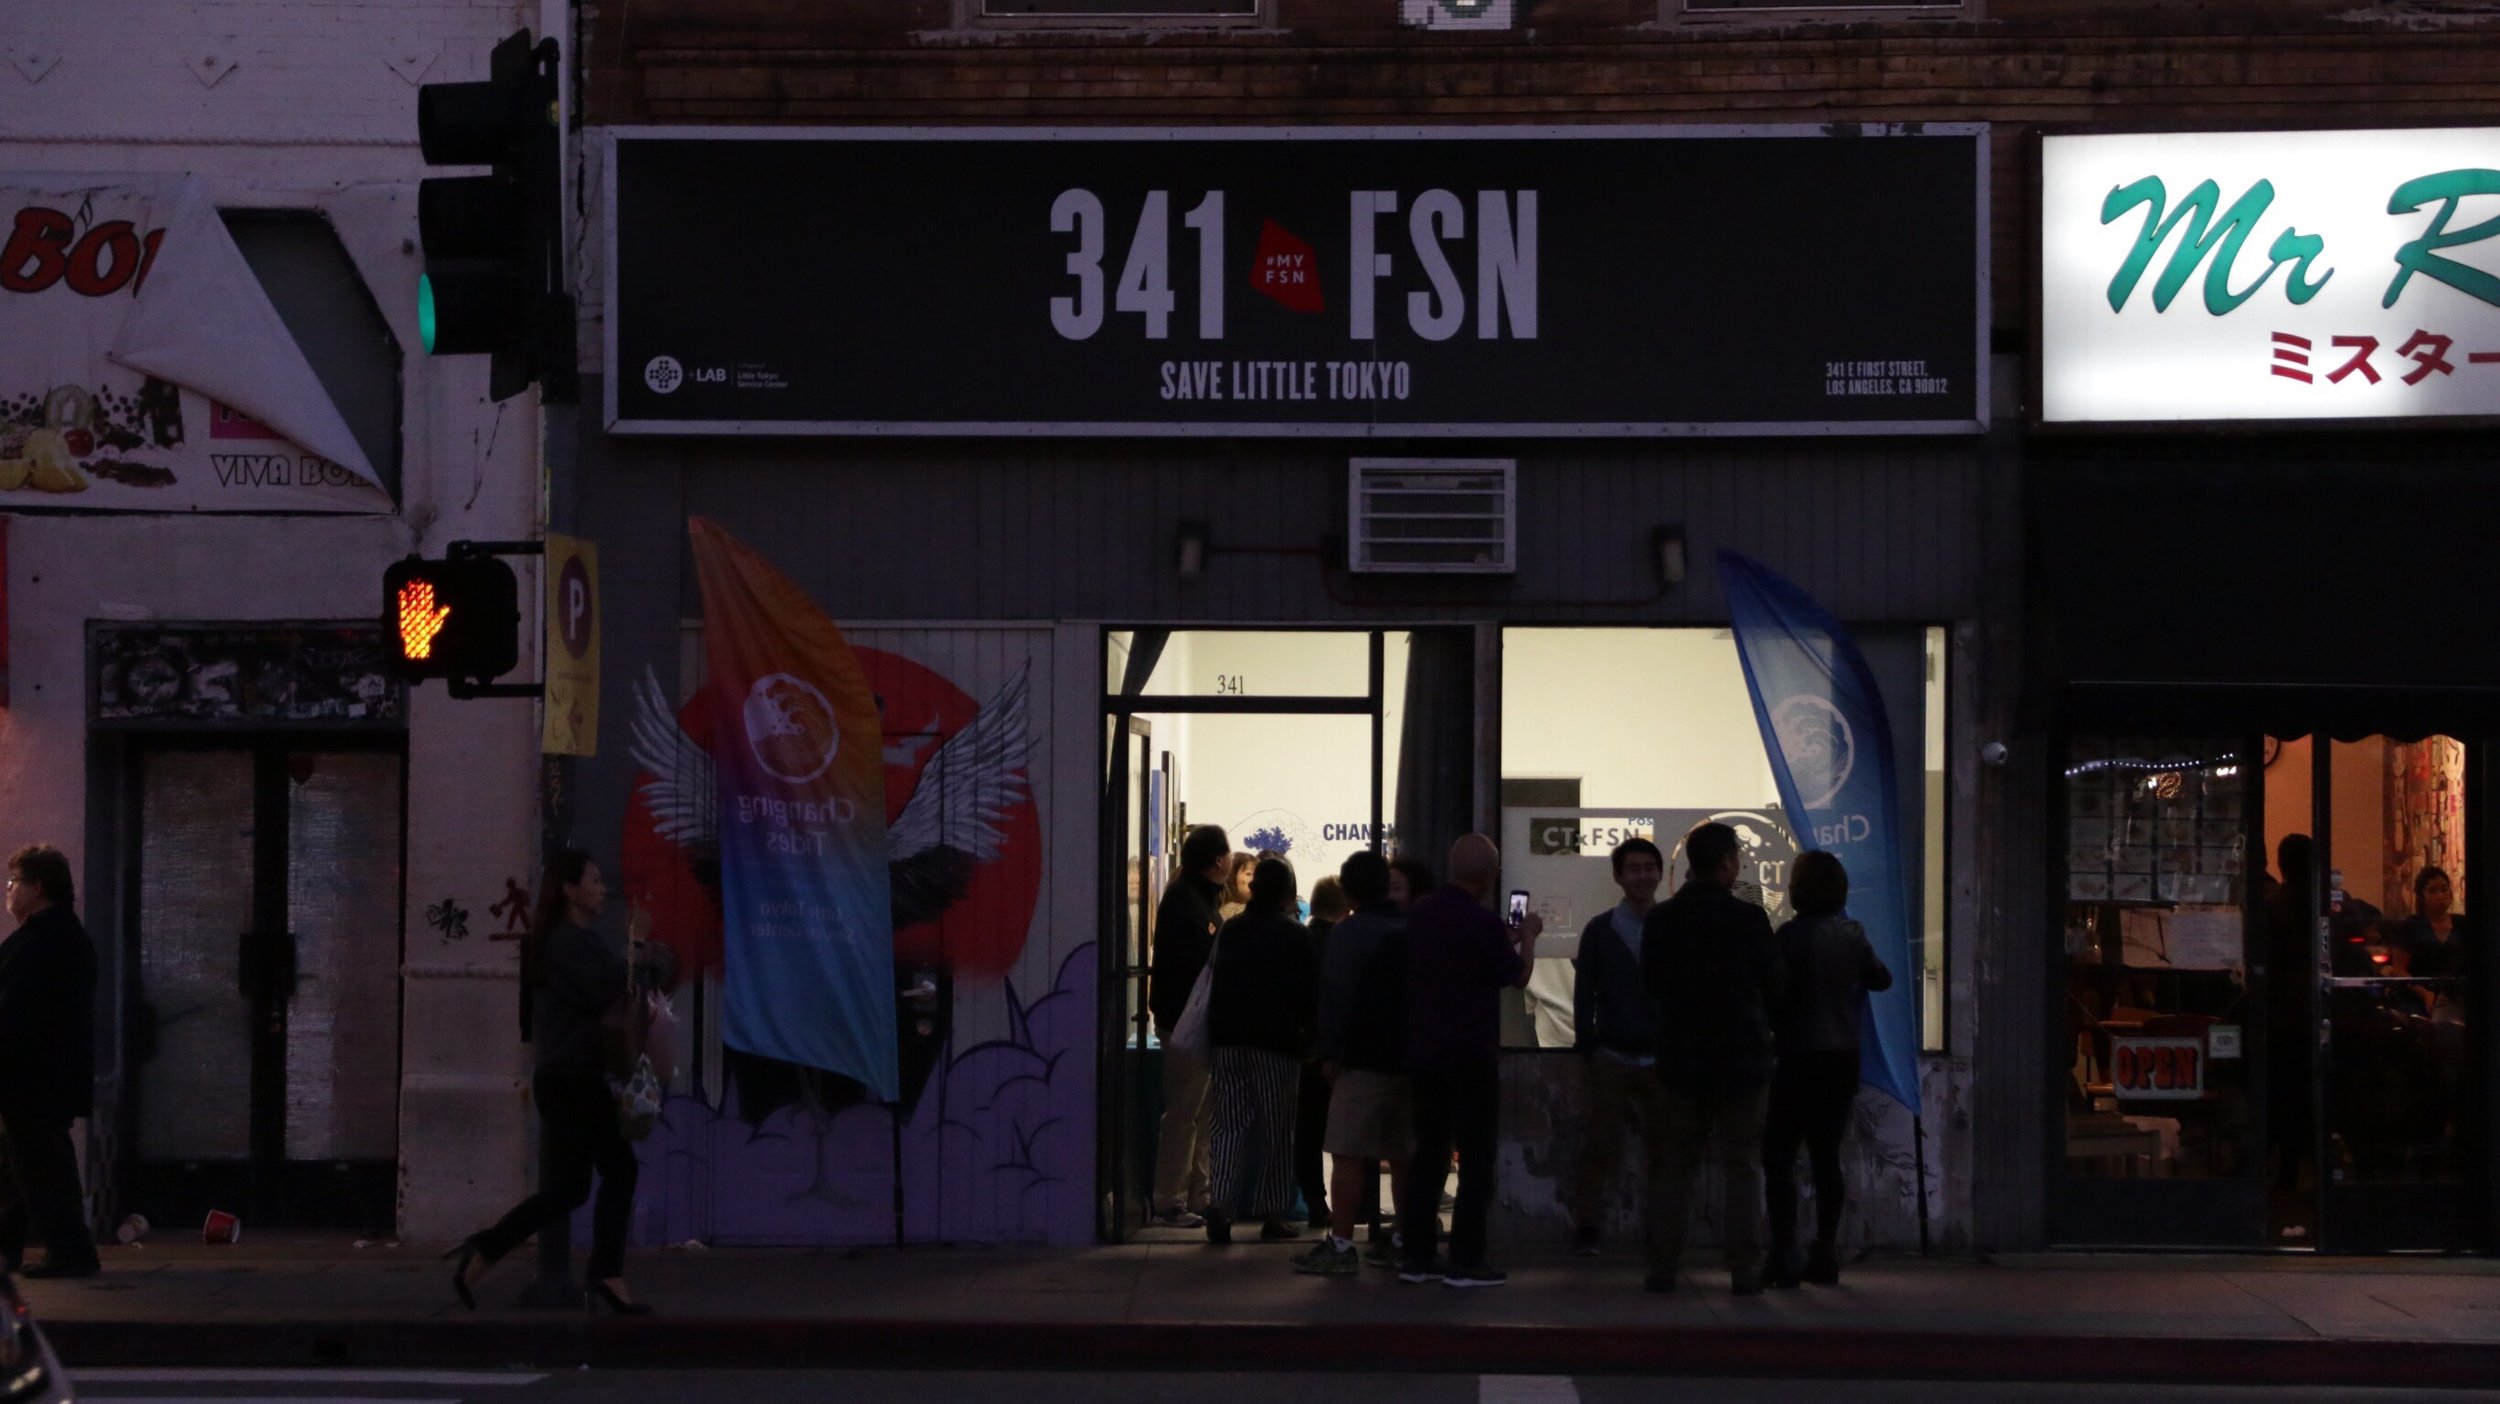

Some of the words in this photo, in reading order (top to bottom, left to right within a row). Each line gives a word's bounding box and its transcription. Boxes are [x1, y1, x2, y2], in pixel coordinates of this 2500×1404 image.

[2100, 174, 2335, 317] Mr
[1050, 187, 1224, 341] 341
[1349, 187, 1538, 341] FSN
[1266, 253, 1304, 268] #MY
[1266, 270, 1304, 284] FSN
[1825, 362, 1845, 378] 341
[1848, 361, 1855, 377] E
[1856, 361, 1886, 377] FIRST
[2270, 328, 2500, 386] ミスター
[764, 380, 789, 389] Center
[1160, 361, 1222, 400] SAVE
[1233, 361, 1318, 400] LITTLE
[1326, 361, 1411, 400] TOKYO
[1825, 379, 1845, 396] LOS
[1899, 378, 1912, 394] CA
[1915, 377, 1948, 394] 90012
[211, 454, 290, 488] VIVA
[568, 577, 585, 641] P
[1217, 674, 1244, 695] 341
[1759, 861, 1786, 885] CT
[2118, 1046, 2198, 1091] OPEN
